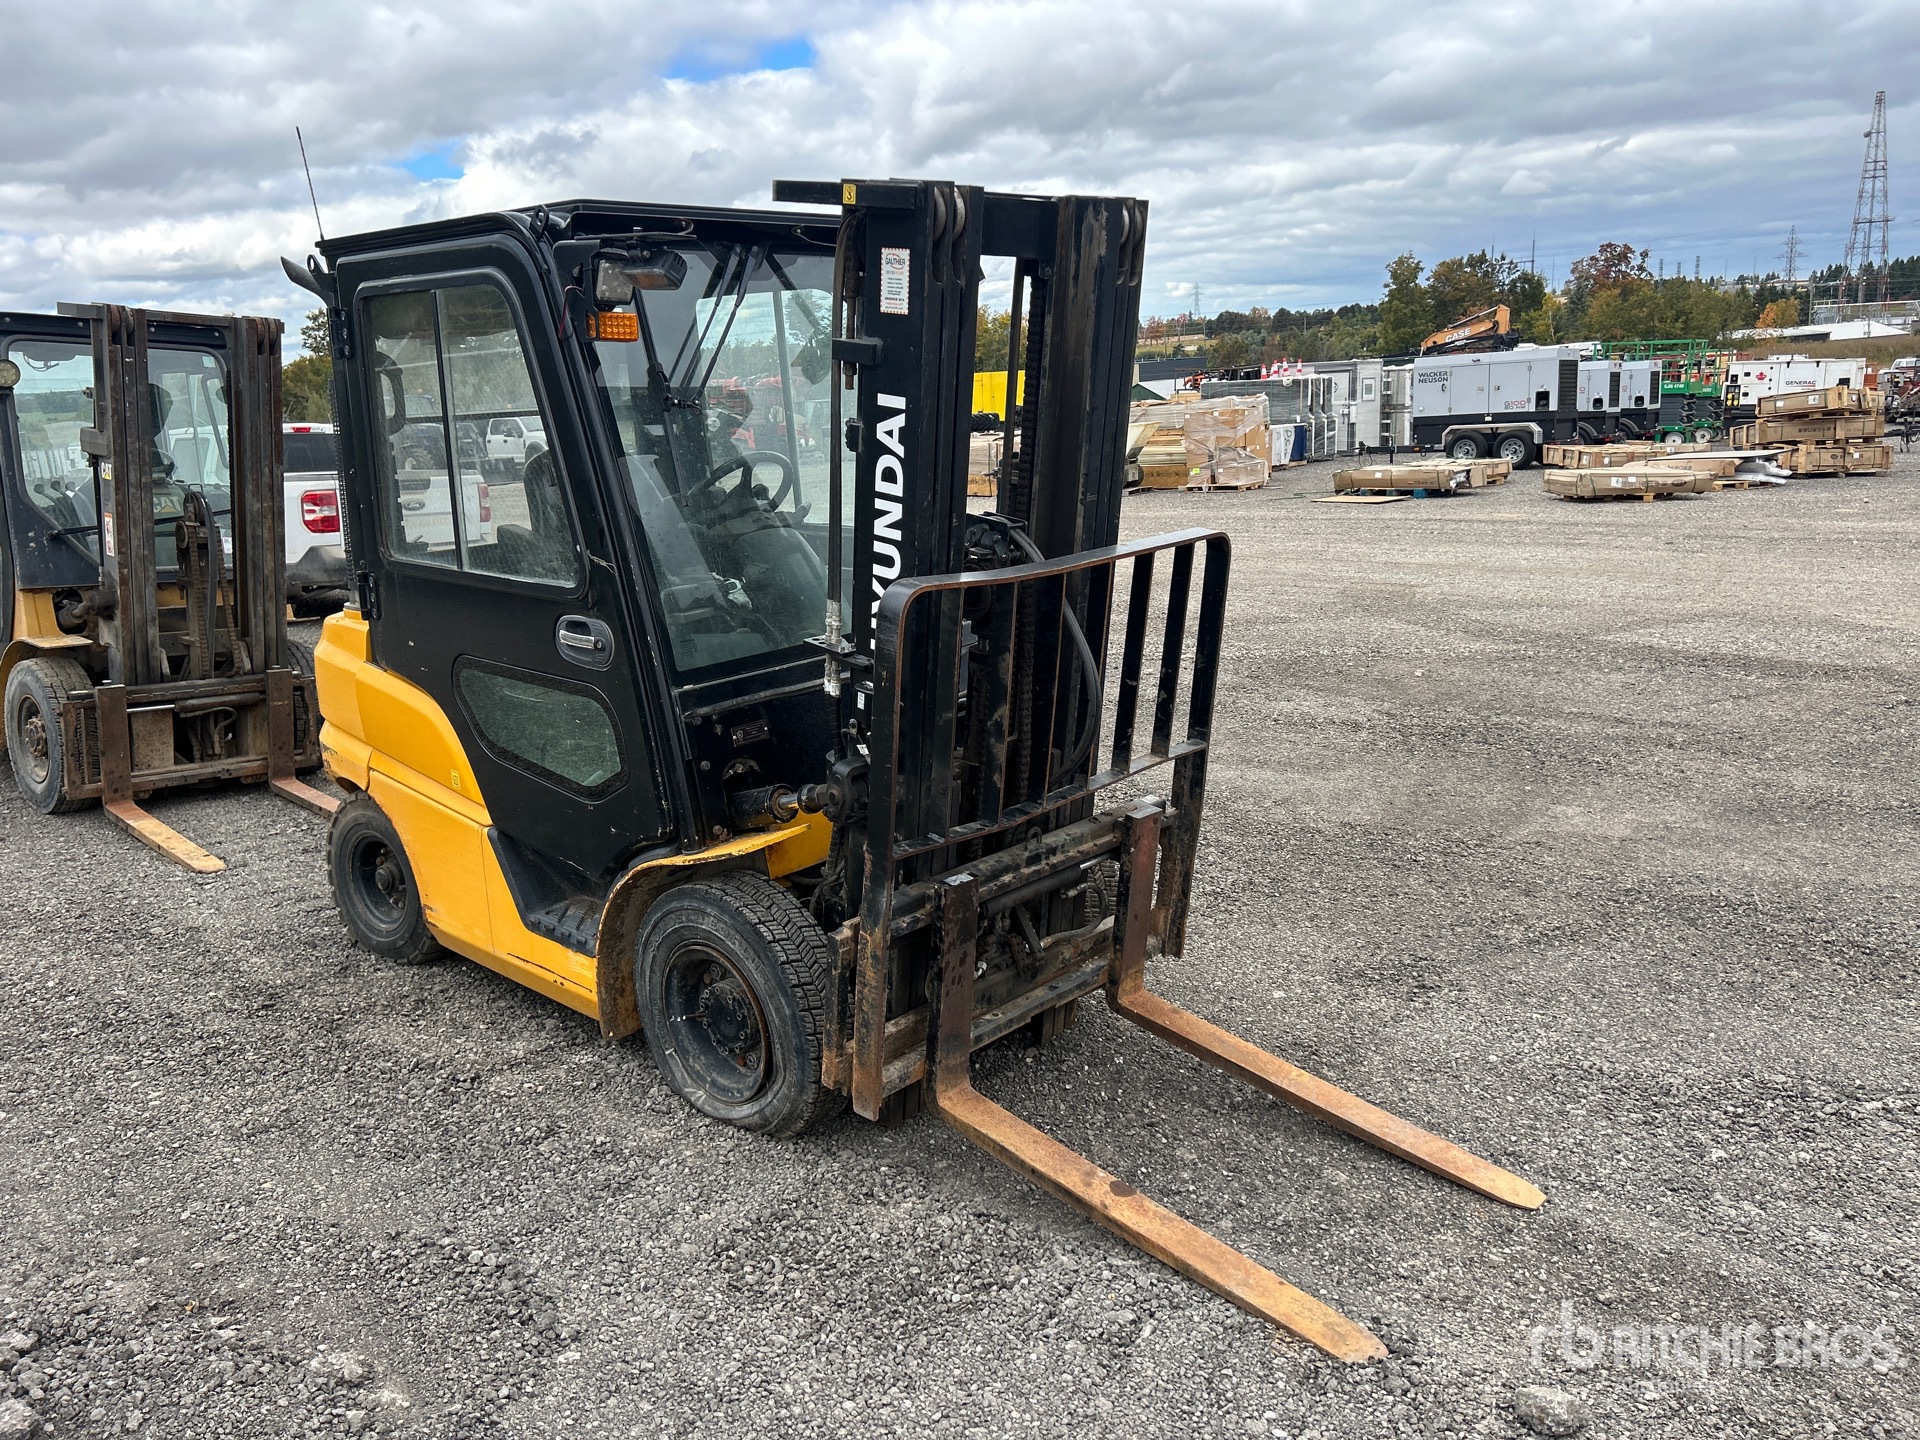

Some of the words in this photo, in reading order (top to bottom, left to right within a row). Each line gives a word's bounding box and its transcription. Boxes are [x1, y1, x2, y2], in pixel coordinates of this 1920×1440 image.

[885, 257, 905, 266] GAUTHIER
[1445, 327, 1471, 342] CASE
[101, 462, 113, 480] CAT
